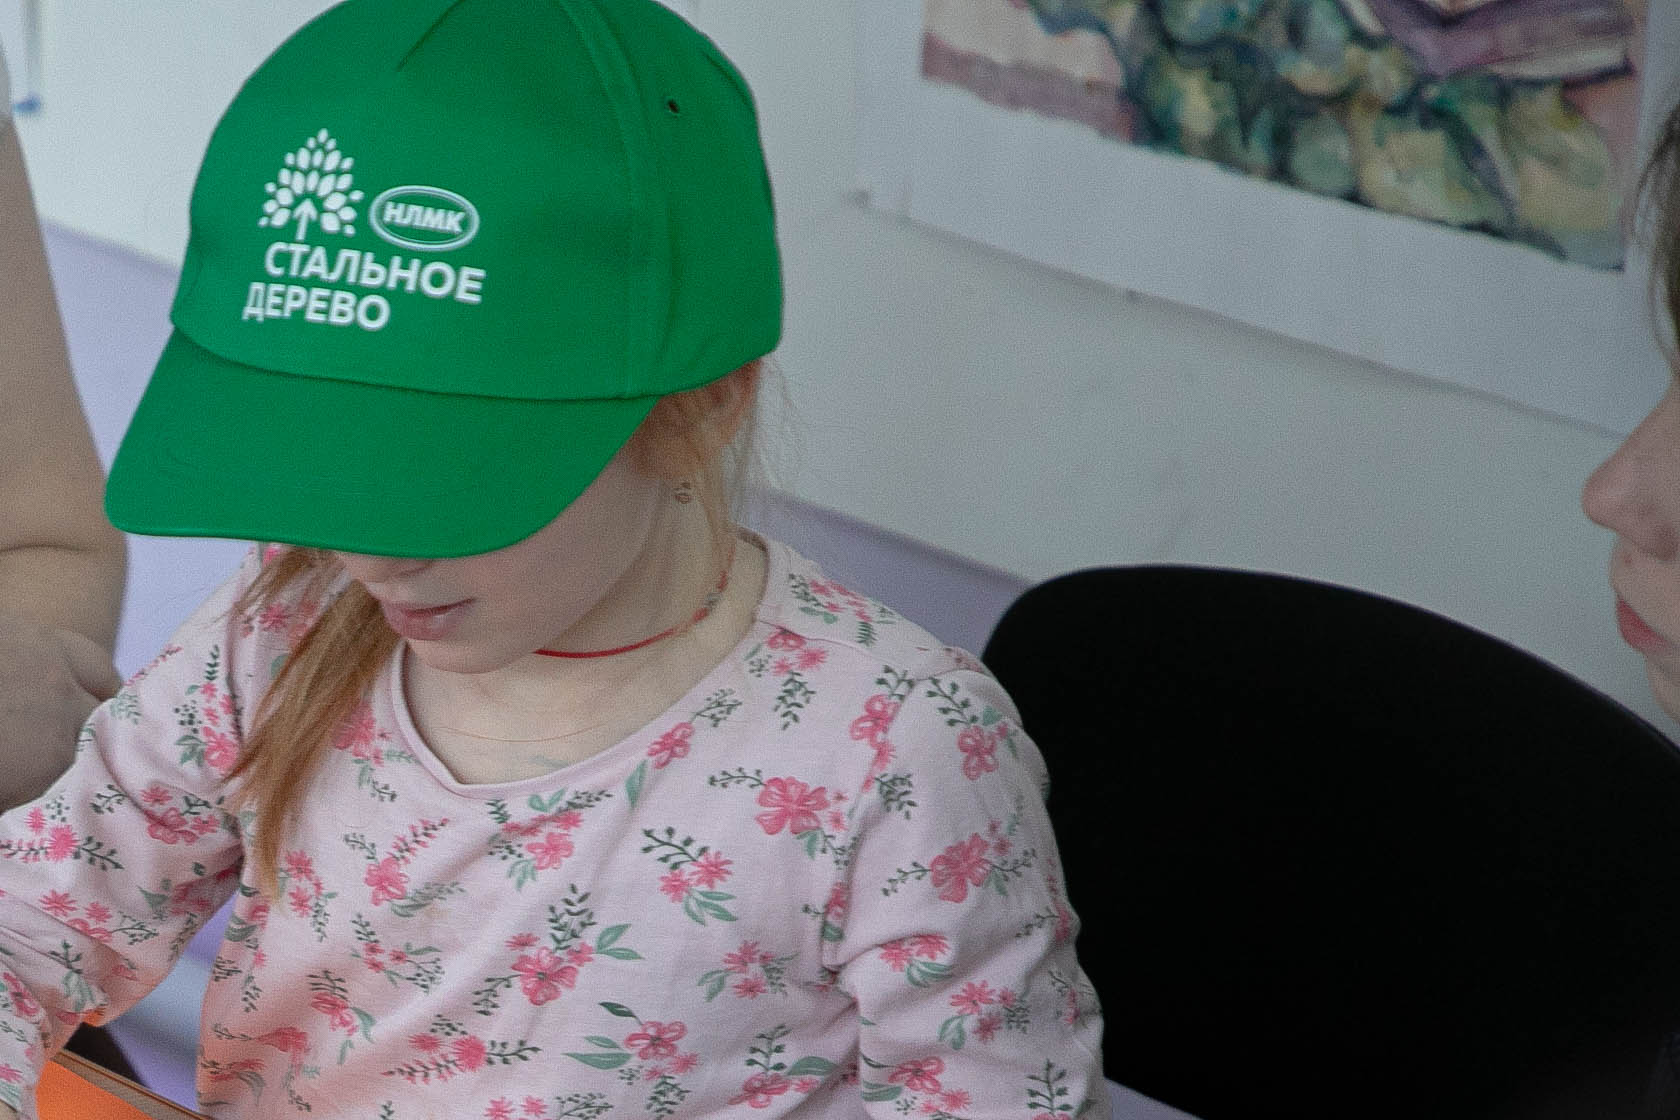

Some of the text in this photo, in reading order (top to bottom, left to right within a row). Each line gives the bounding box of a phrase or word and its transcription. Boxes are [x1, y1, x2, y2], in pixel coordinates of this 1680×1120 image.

[383, 201, 467, 235] НЛМК
[264, 241, 487, 305] СТАЛЬНОЕ
[242, 282, 392, 332] ДЕРЕВО
